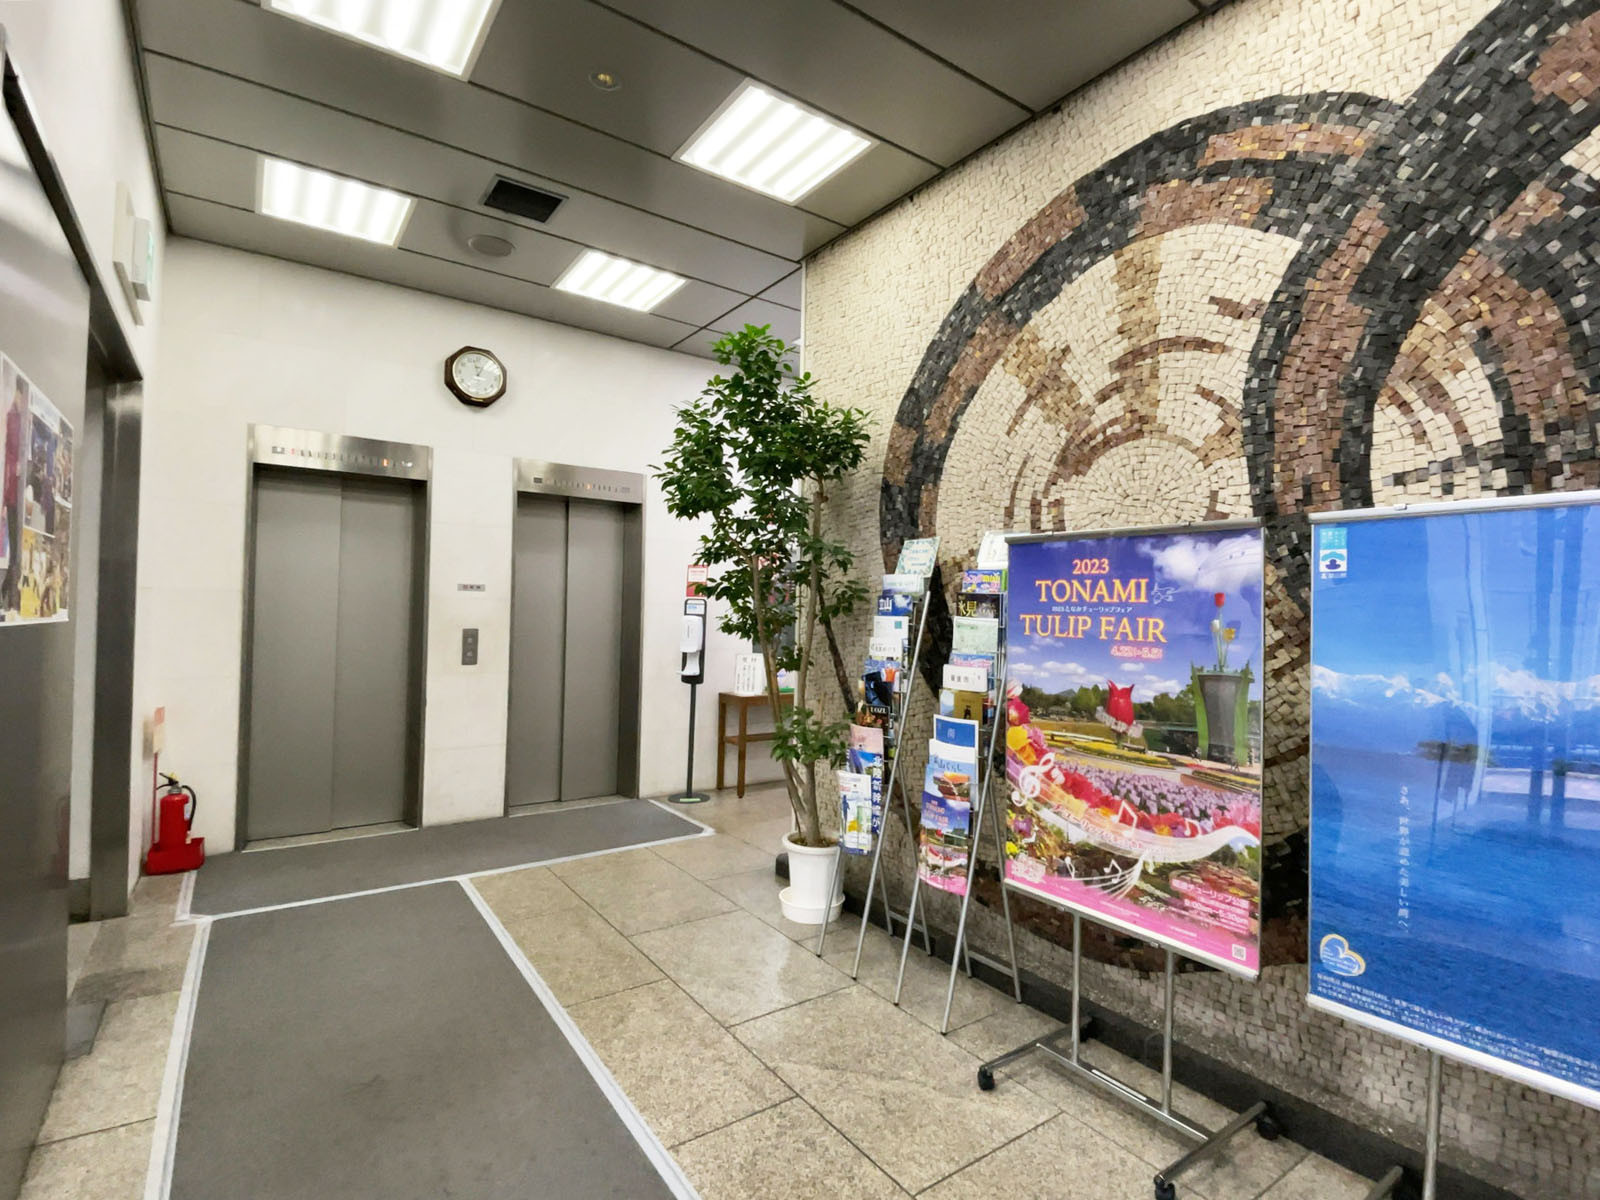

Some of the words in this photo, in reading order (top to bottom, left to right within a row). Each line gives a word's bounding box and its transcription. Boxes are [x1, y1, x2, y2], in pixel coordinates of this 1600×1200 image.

[1072, 557, 1110, 575] 2023
[1035, 578, 1149, 604] TONAMI
[1019, 613, 1092, 638] TULIP
[1099, 616, 1168, 643] FAIR
